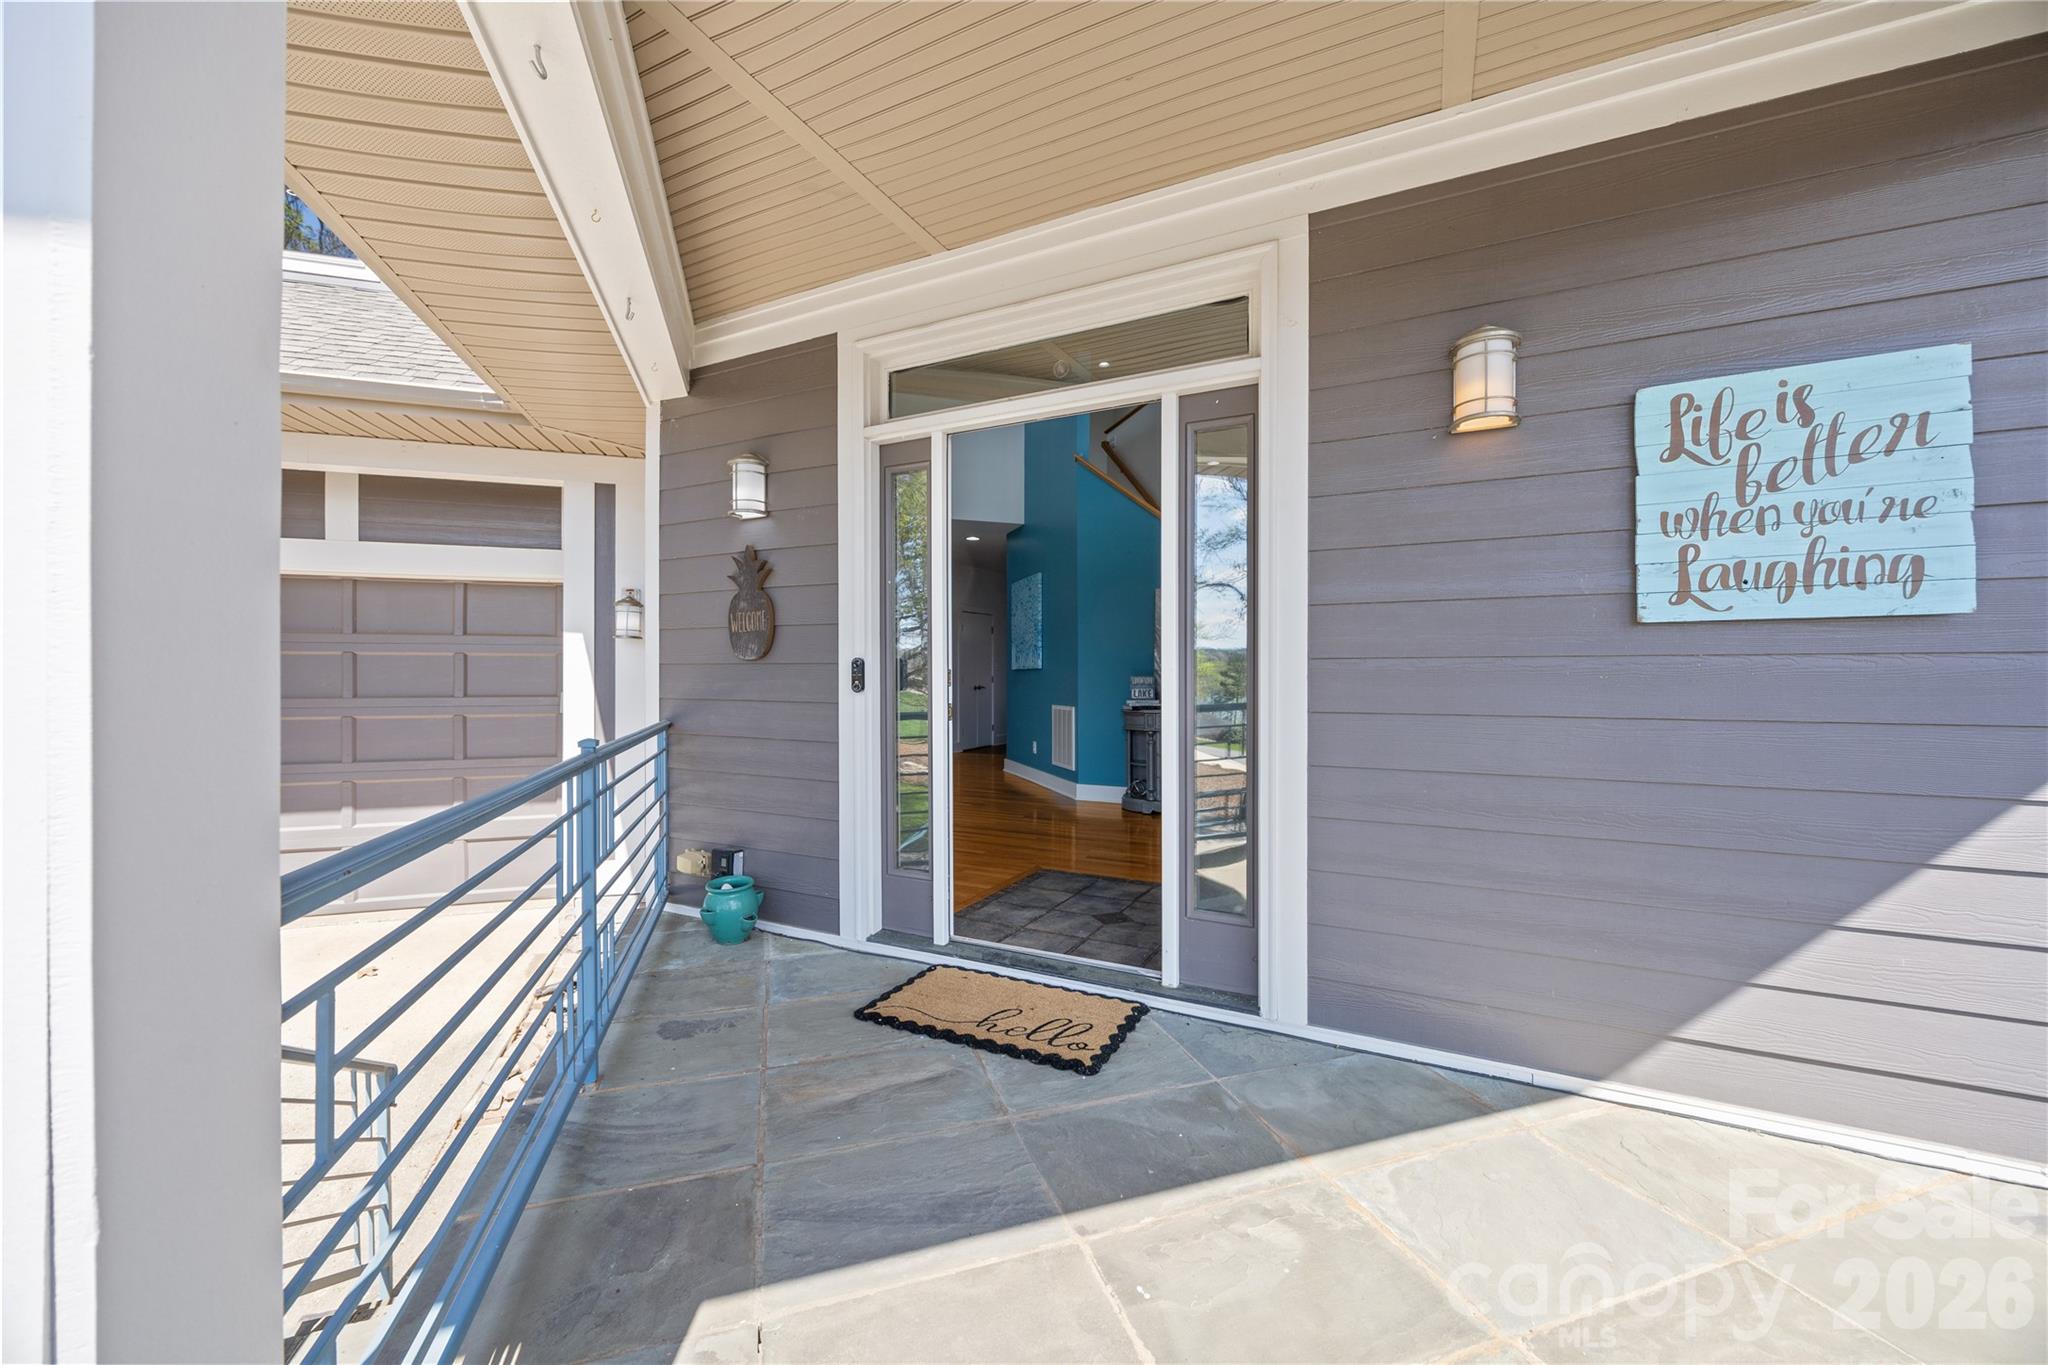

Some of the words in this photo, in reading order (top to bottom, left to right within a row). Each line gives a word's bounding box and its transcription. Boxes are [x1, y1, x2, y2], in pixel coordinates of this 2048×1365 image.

[1659, 386, 1772, 467] Life
[1775, 379, 1816, 428] is
[1735, 410, 1940, 508] better
[1659, 491, 1782, 541] when
[1793, 487, 1938, 538] you're
[1668, 535, 1934, 612] Laughing
[731, 610, 767, 633] WELCOME
[975, 1008, 1095, 1051] hello
